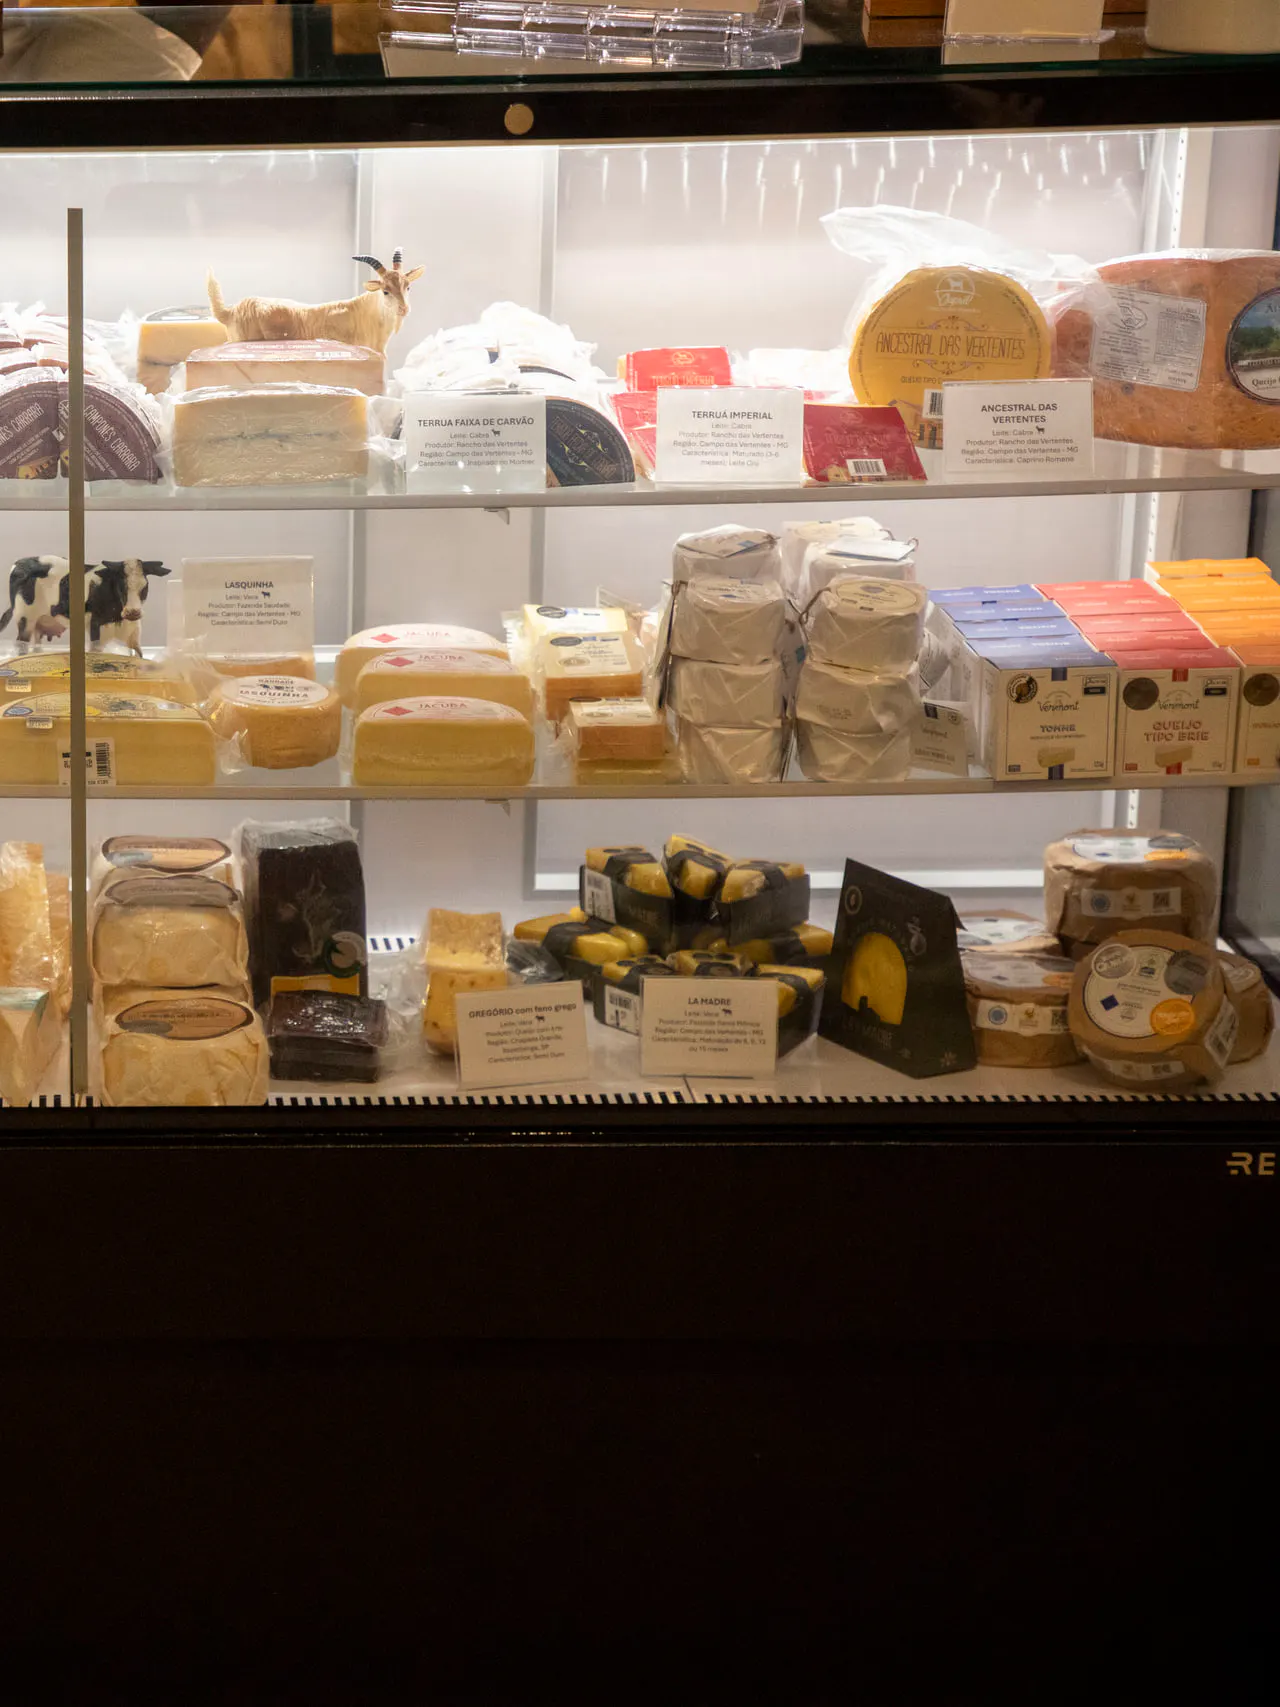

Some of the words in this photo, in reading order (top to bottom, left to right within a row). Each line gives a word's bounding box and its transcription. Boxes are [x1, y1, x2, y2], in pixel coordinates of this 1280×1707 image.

[875, 332, 934, 355] ANCESTRAL
[939, 335, 961, 356] DAS
[966, 336, 1026, 360] VERTENTES
[981, 404, 1036, 413] ANCESTRAL
[1038, 403, 1058, 411] DAS
[11, 403, 45, 432] CARRARA
[692, 409, 728, 420] TERRUÁ
[730, 411, 773, 420] IMPERIAL
[992, 415, 1046, 424] VERTENTES
[418, 419, 455, 428] TERRUA
[455, 418, 480, 427] FAIXA
[482, 418, 494, 426] DE
[497, 416, 534, 426] CARVÃO
[83, 404, 116, 442] CAMPONÊS
[110, 438, 141, 472] CARRARA
[225, 581, 274, 590] LASQUINHA
[1152, 720, 1203, 731] QUEIJO
[1144, 731, 1174, 742] TIPO
[1177, 731, 1210, 741] BRIE
[688, 997, 699, 1006] LA
[701, 998, 731, 1006] MADRE
[468, 1007, 513, 1019] GREGÓRIO
[534, 1005, 553, 1013] feno
